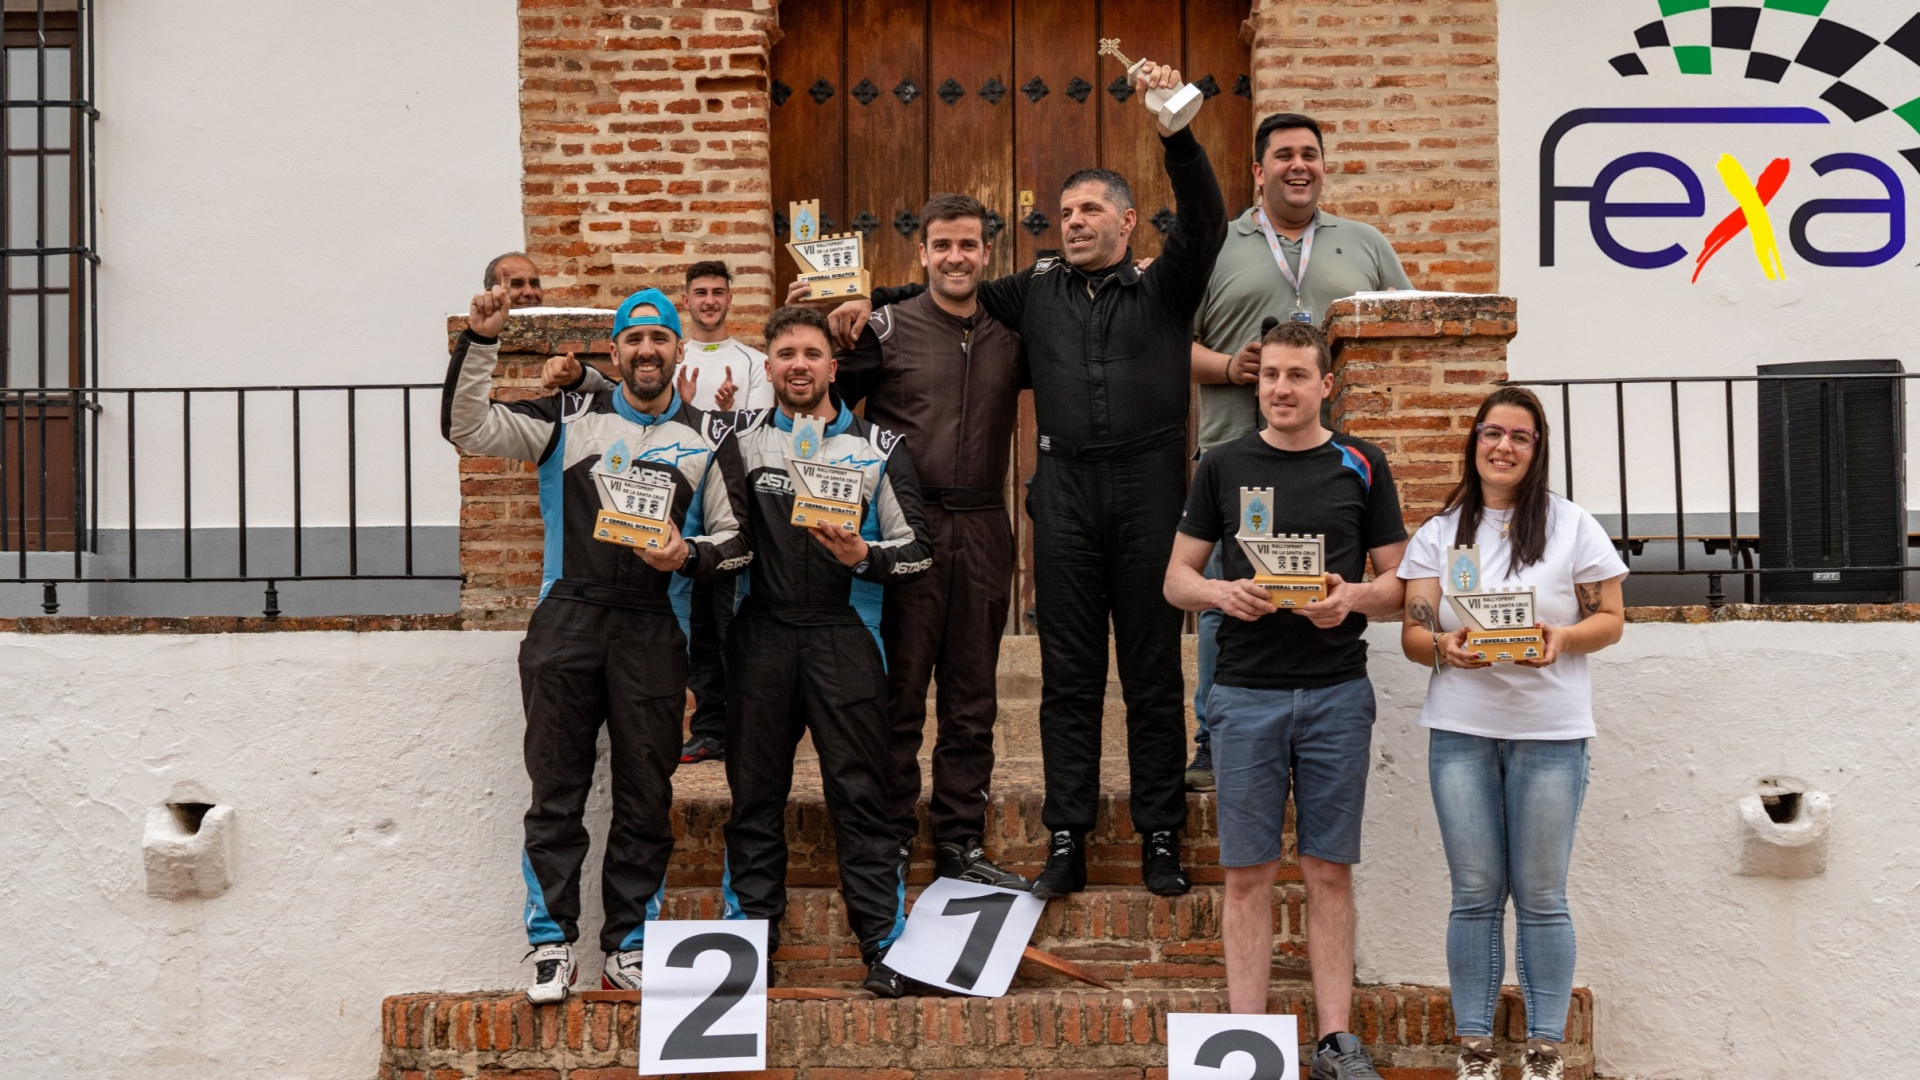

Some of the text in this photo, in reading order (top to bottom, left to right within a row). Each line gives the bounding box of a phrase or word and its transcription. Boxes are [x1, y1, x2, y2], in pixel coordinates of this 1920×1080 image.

[817, 240, 844, 248] RALLYSPRINT
[804, 245, 815, 255] VII
[804, 466, 815, 477] VII
[817, 467, 848, 476] RALLYSPRINT
[610, 480, 622, 492] VII
[624, 482, 654, 492] RALLYSPRINT
[636, 490, 652, 499] SANTA
[804, 503, 830, 512] GENERAL
[831, 507, 857, 516] SCRATCH
[608, 518, 634, 528] GENERAL
[635, 524, 662, 533] SCRATCH
[1257, 544, 1270, 554] VII
[1468, 599, 1481, 609] VII
[941, 891, 1018, 990] 1
[659, 932, 759, 1060] 2
